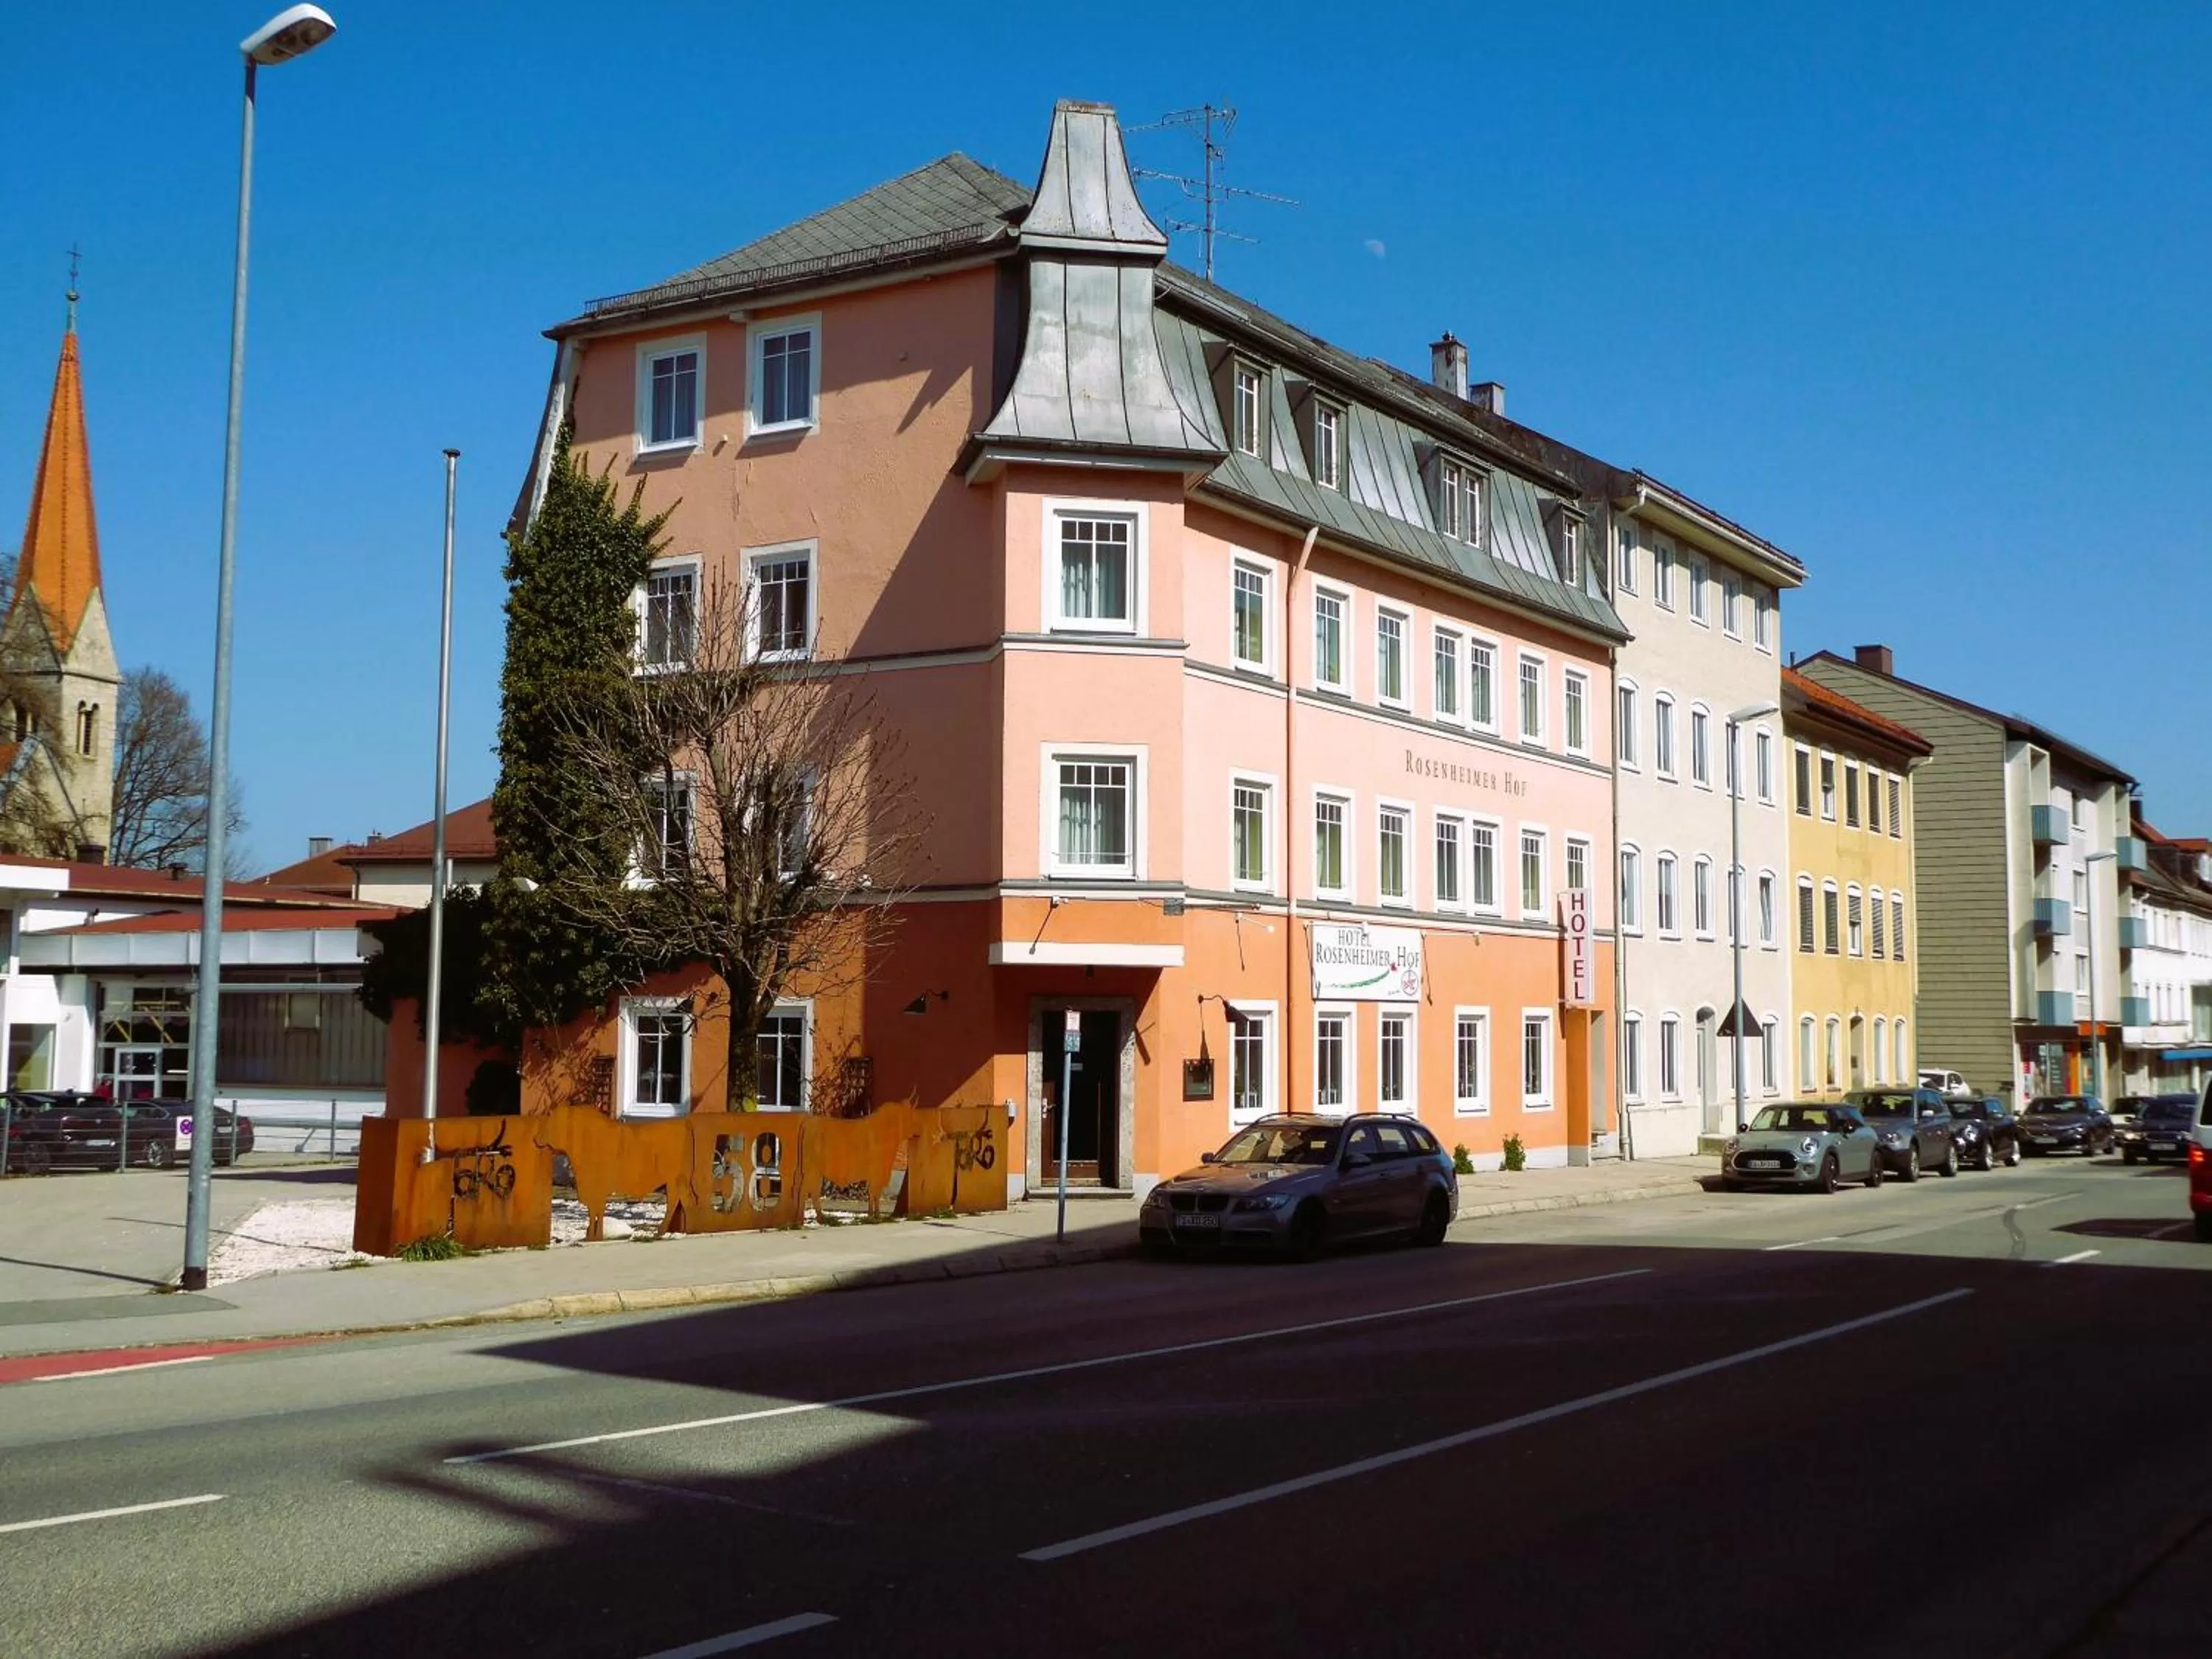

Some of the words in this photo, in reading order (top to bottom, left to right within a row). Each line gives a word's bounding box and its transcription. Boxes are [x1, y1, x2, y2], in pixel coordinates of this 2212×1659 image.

[1405, 748, 1497, 790] ROSENHEIMER
[1503, 771, 1528, 797] HOF
[1316, 942, 1391, 967] ROSENHEIMER
[1397, 945, 1420, 968] HOF
[1338, 928, 1372, 947] HOTEL
[1571, 892, 1586, 1000] HOTEL
[711, 1133, 782, 1213] 58
